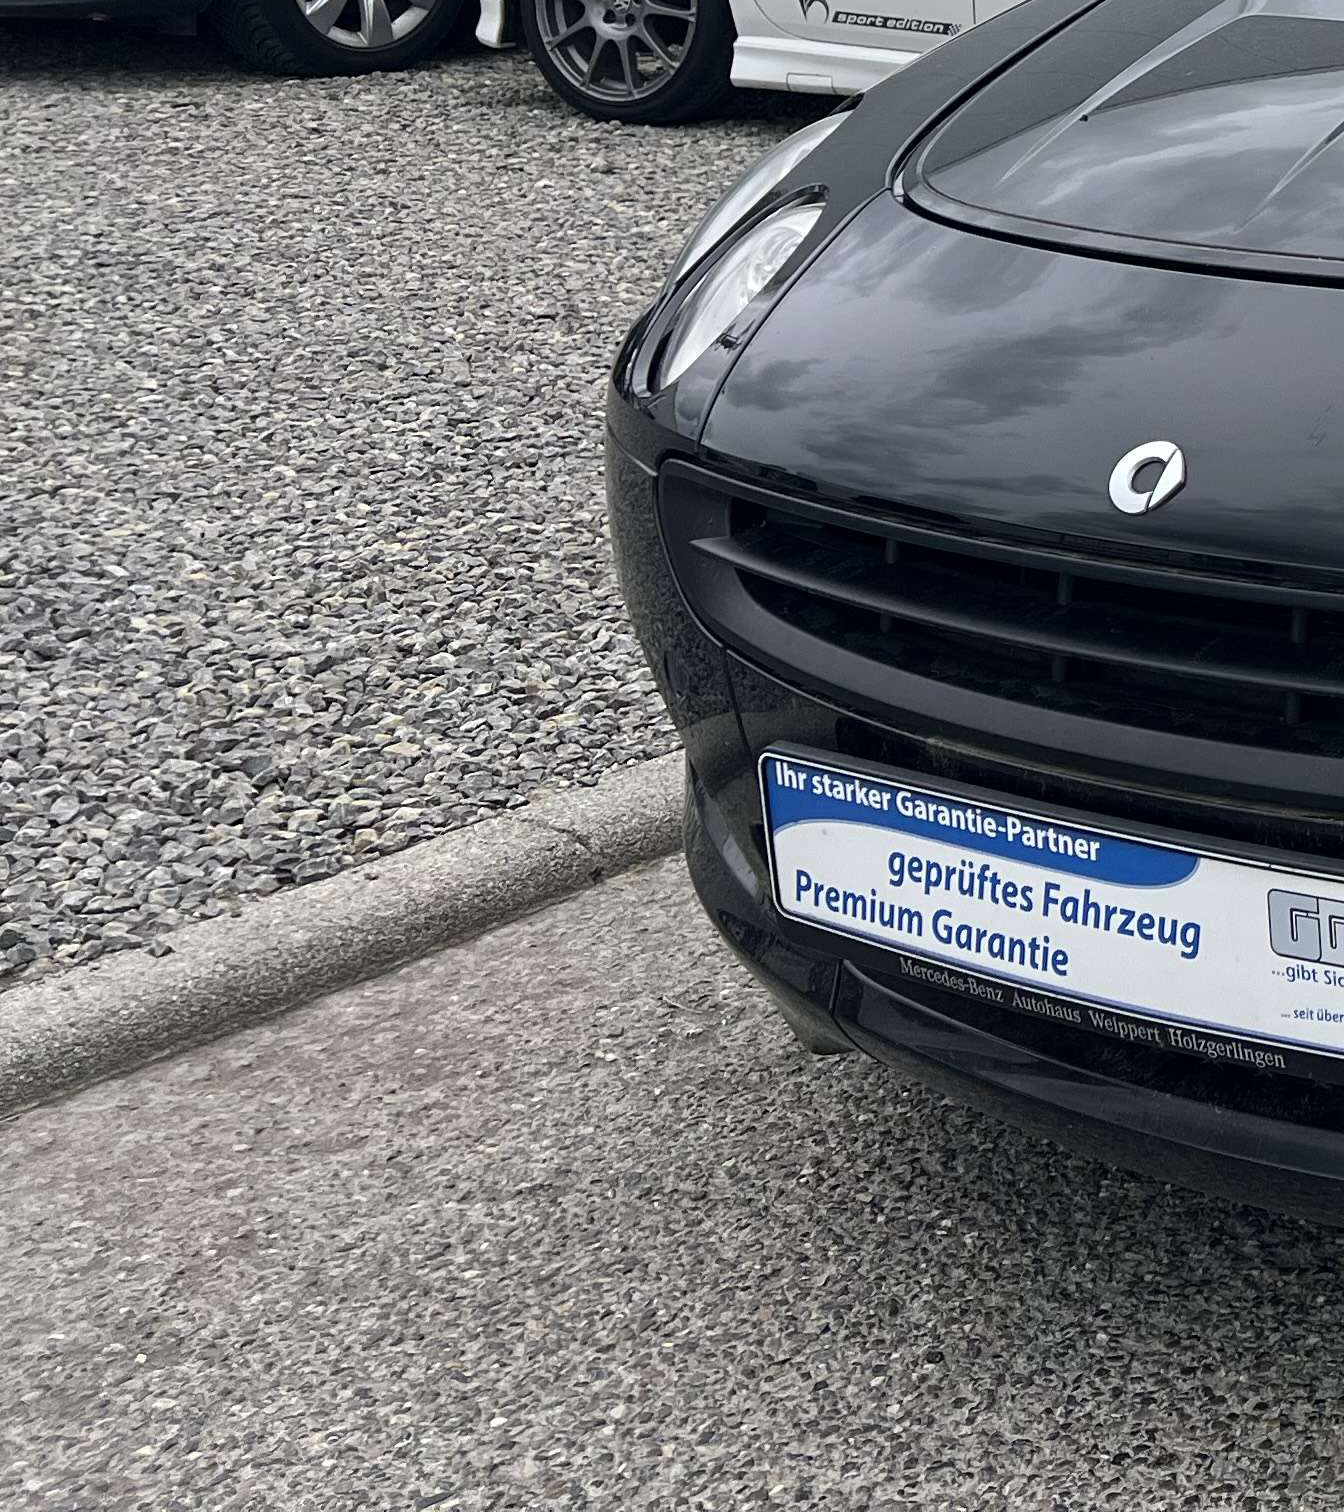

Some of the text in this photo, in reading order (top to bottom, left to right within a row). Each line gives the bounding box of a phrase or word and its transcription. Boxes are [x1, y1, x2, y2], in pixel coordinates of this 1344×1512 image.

[836, 12, 944, 34] sport edition
[775, 761, 1100, 862] Ihr starker Garantie-Partner
[796, 869, 1069, 977] Premium Garantie
[888, 851, 1201, 960] geprüftes Fahrzeug
[900, 956, 1005, 1003] Mercedes-Benz
[1012, 988, 1082, 1024] Autohaus
[1168, 1027, 1287, 1069] Holzgerlingen
[1293, 1007, 1314, 1020] seit
[1316, 1008, 1344, 1024] über
